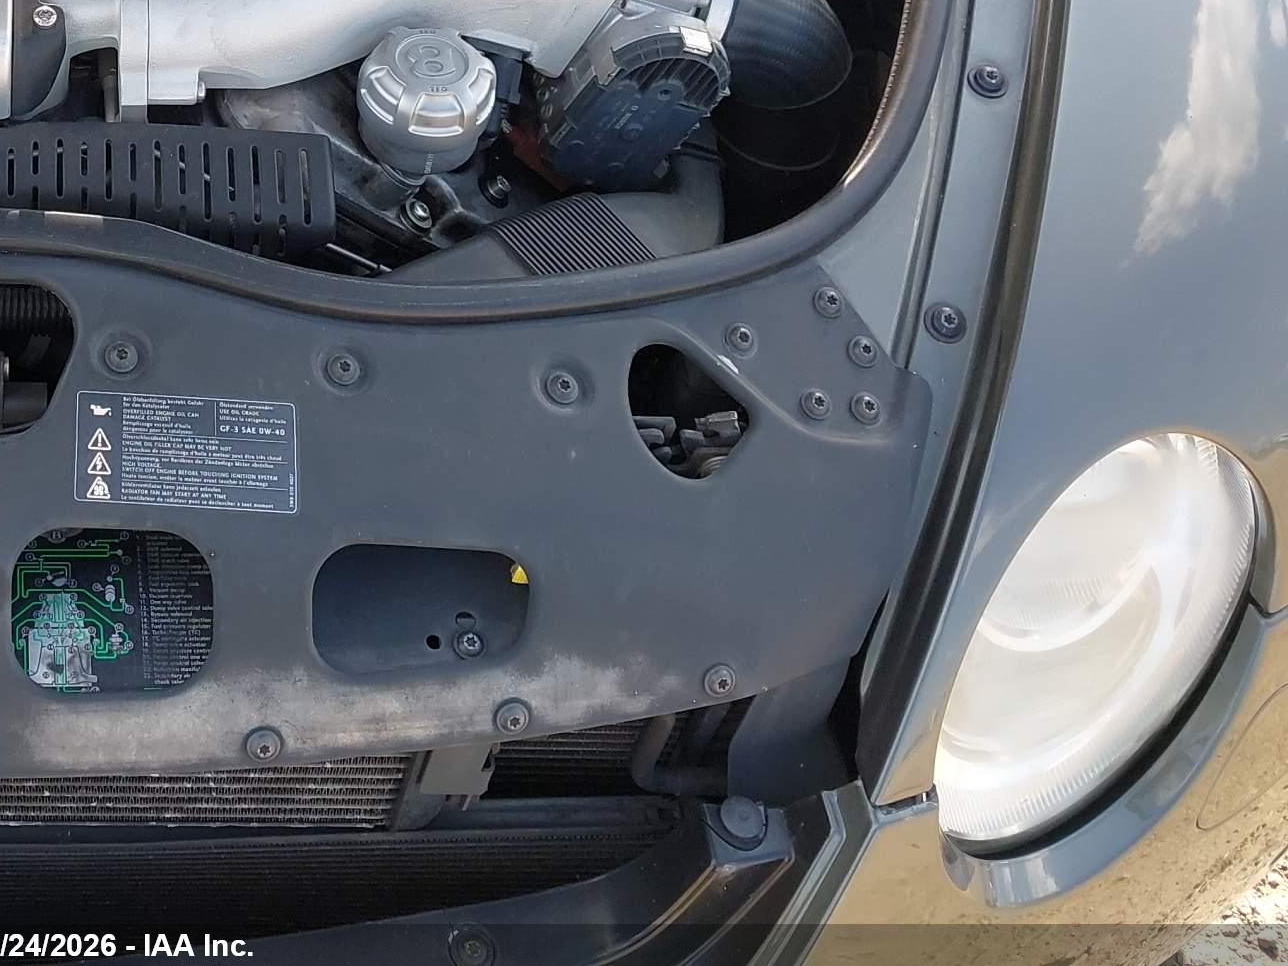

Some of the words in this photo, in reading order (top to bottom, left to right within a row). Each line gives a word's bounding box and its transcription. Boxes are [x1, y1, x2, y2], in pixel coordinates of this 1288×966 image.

[220, 425, 238, 433] GF-3
[241, 426, 256, 434] SAE
[259, 427, 285, 436] 0W-40
